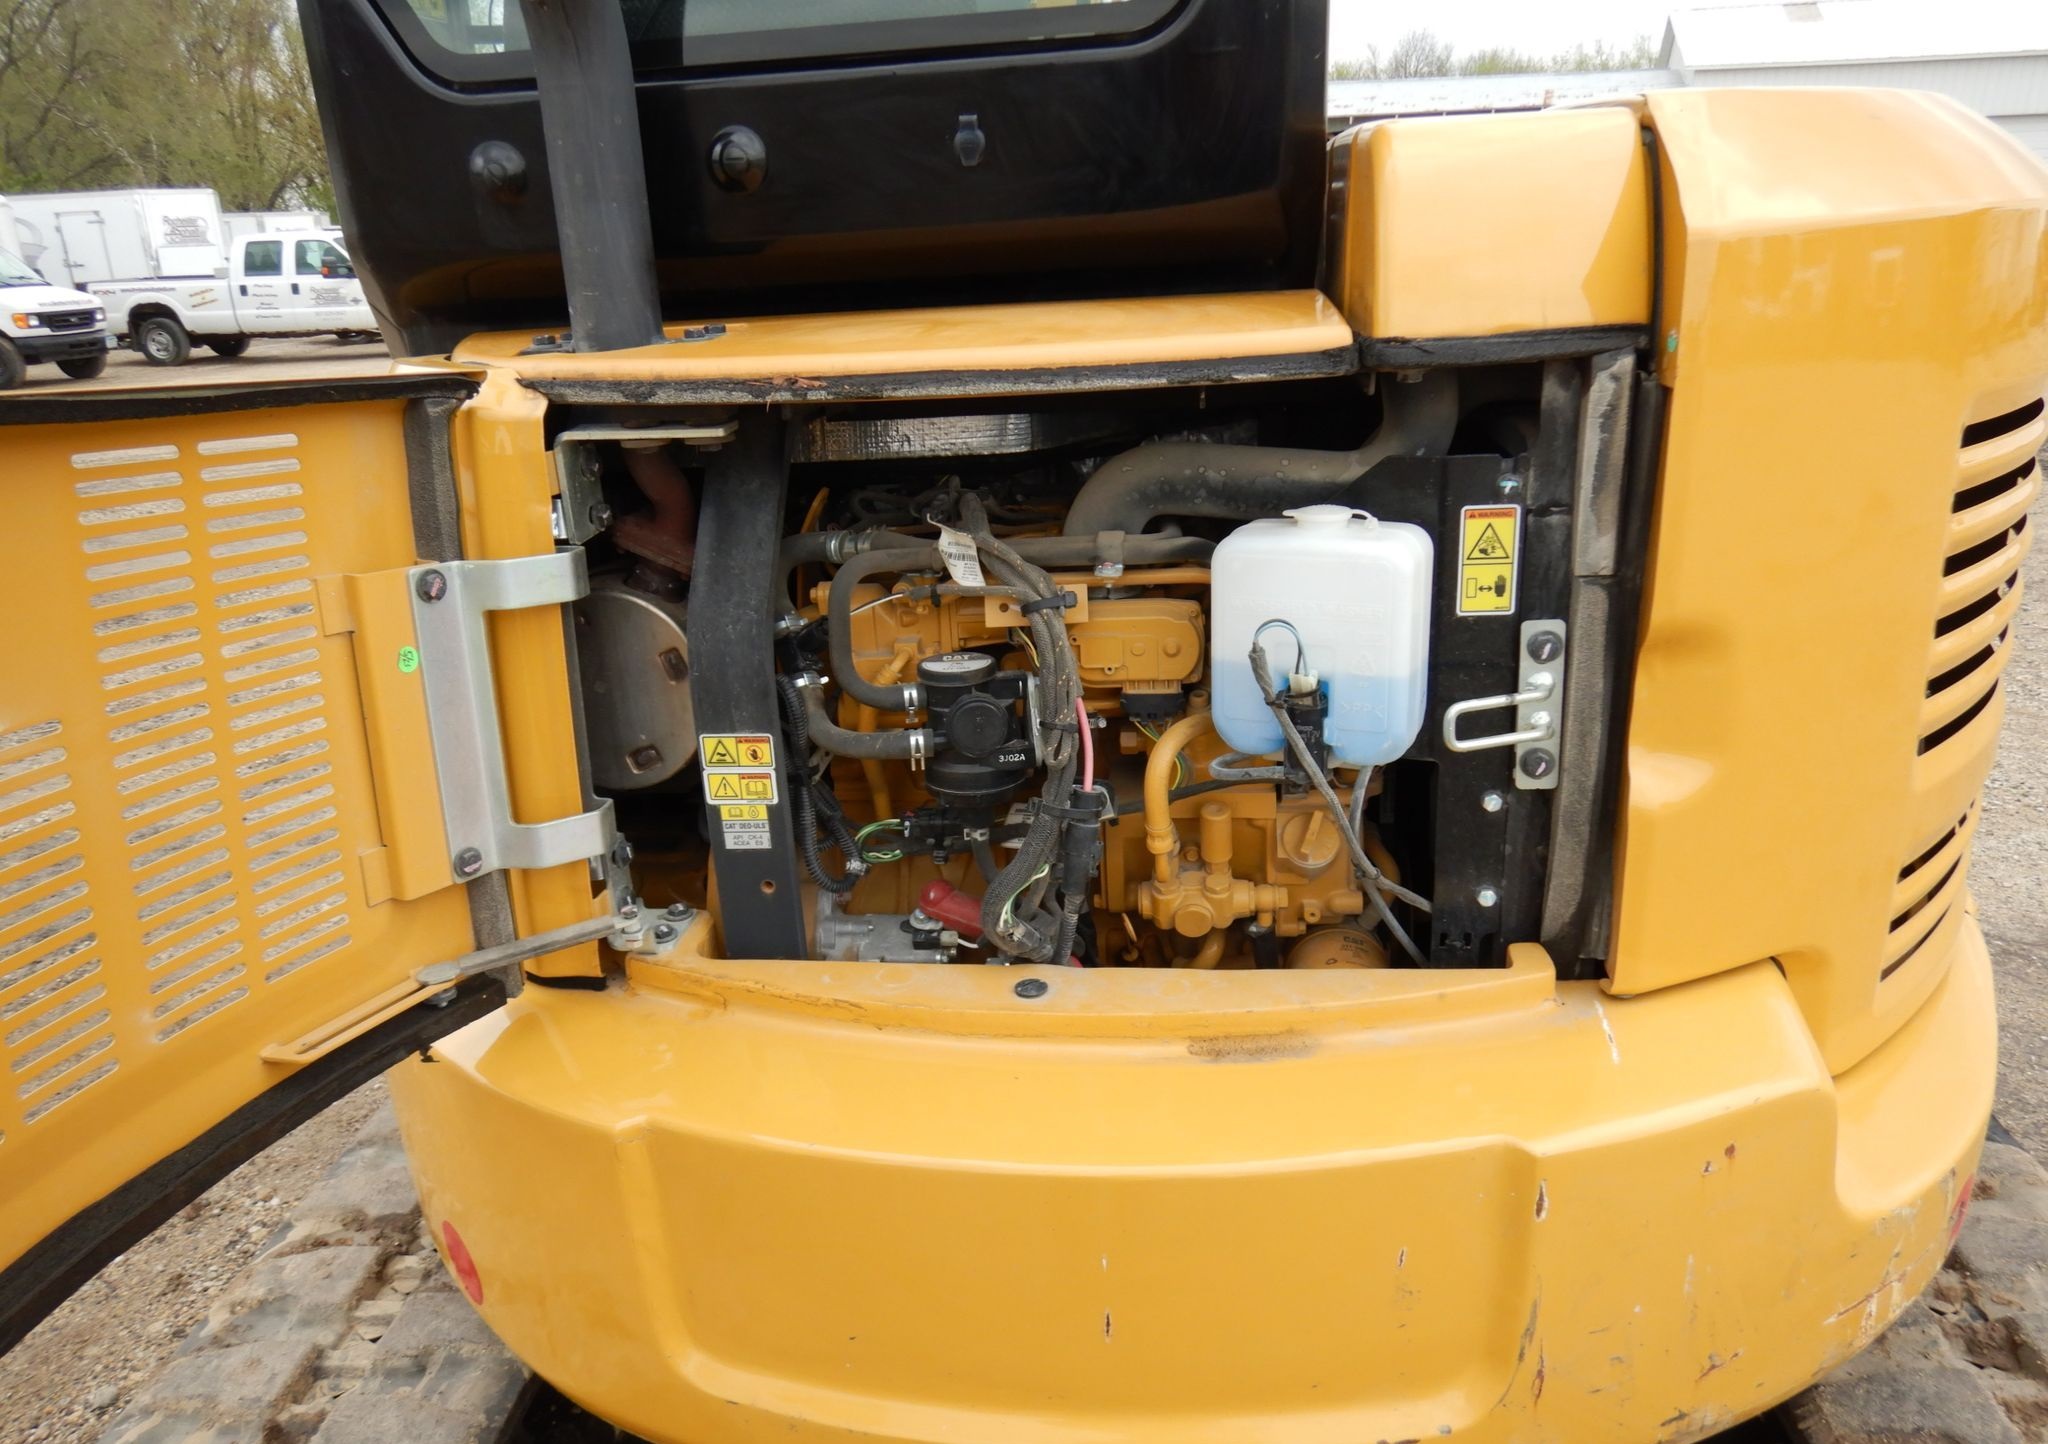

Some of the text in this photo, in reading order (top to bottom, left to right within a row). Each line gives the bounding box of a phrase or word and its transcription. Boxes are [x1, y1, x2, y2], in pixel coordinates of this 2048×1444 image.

[1478, 510, 1512, 518] WARNING
[942, 654, 970, 662] CAT
[998, 752, 1026, 763] 3J02A
